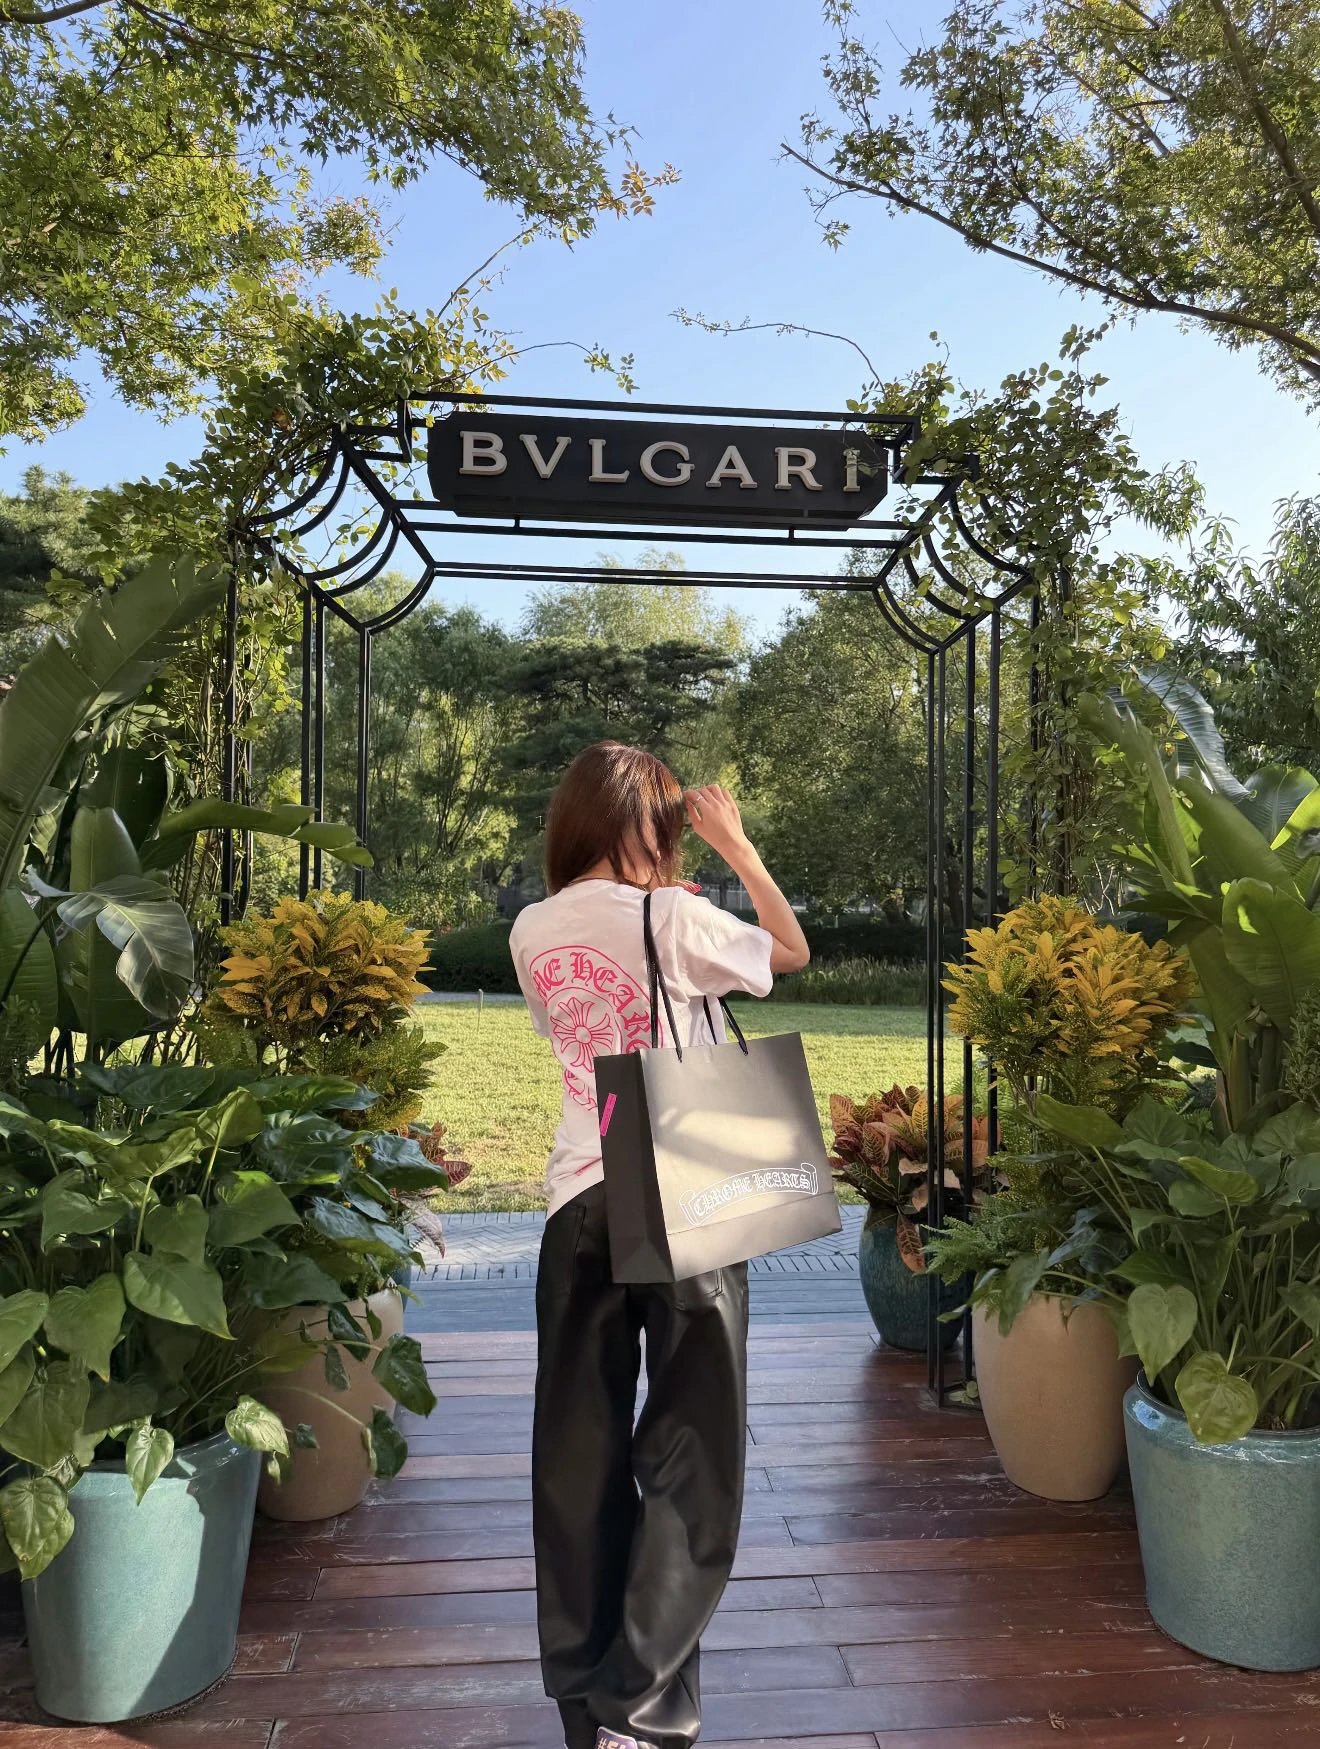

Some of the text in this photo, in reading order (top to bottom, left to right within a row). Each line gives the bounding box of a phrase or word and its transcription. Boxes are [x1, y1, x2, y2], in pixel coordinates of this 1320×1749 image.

[459, 430, 861, 493] BVLGARI
[692, 1171, 812, 1217] CHROME HEARTS
